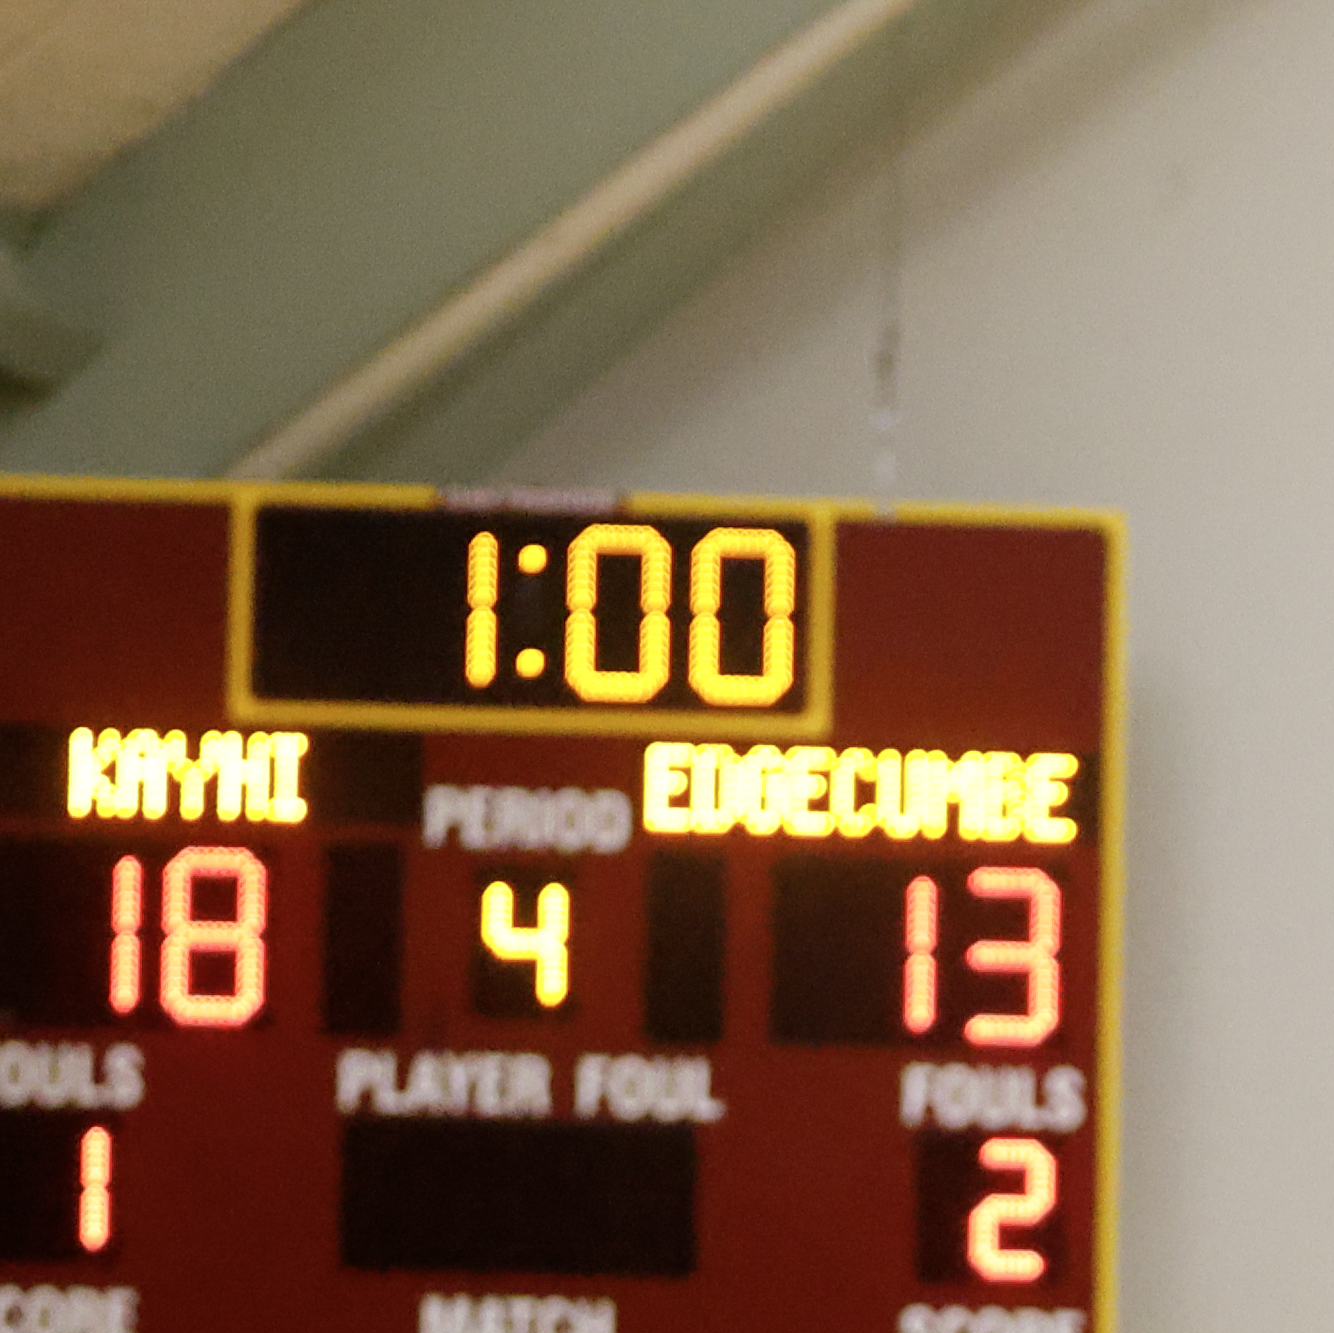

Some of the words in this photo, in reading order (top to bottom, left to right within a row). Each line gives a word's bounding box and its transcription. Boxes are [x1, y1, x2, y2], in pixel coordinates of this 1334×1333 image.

[465, 523, 797, 707] 1:00
[67, 727, 309, 824] KAYHI
[421, 784, 633, 855] PERIOD
[643, 741, 1079, 843] EDGECUMBE
[111, 847, 268, 1028] 18
[480, 880, 570, 1008] 4
[904, 866, 1061, 1048] 13
[0, 1039, 146, 1111] OULS
[336, 1047, 553, 1118] PLAYER
[573, 1052, 727, 1123] FOUL
[900, 1061, 1087, 1132] FOULS
[78, 1126, 112, 1253] 1
[966, 1138, 1057, 1283] 2
